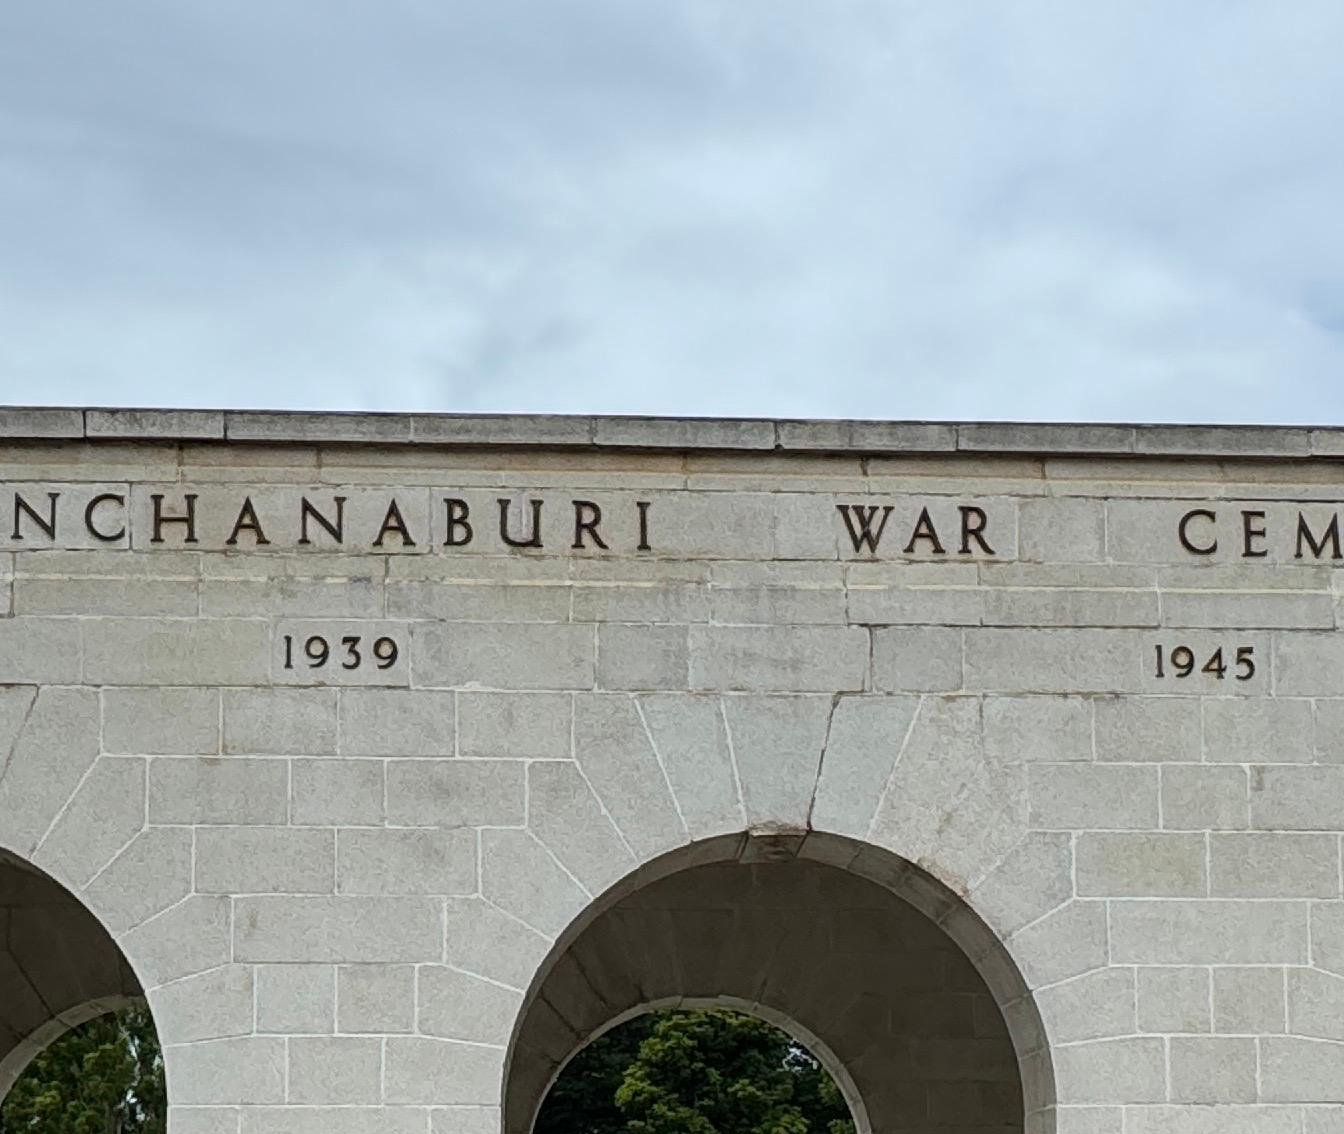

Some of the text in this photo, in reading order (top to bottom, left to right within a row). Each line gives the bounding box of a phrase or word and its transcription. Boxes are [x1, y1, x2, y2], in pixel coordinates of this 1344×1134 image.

[835, 503, 996, 556] WAR
[283, 634, 1257, 681] 1939 1945
